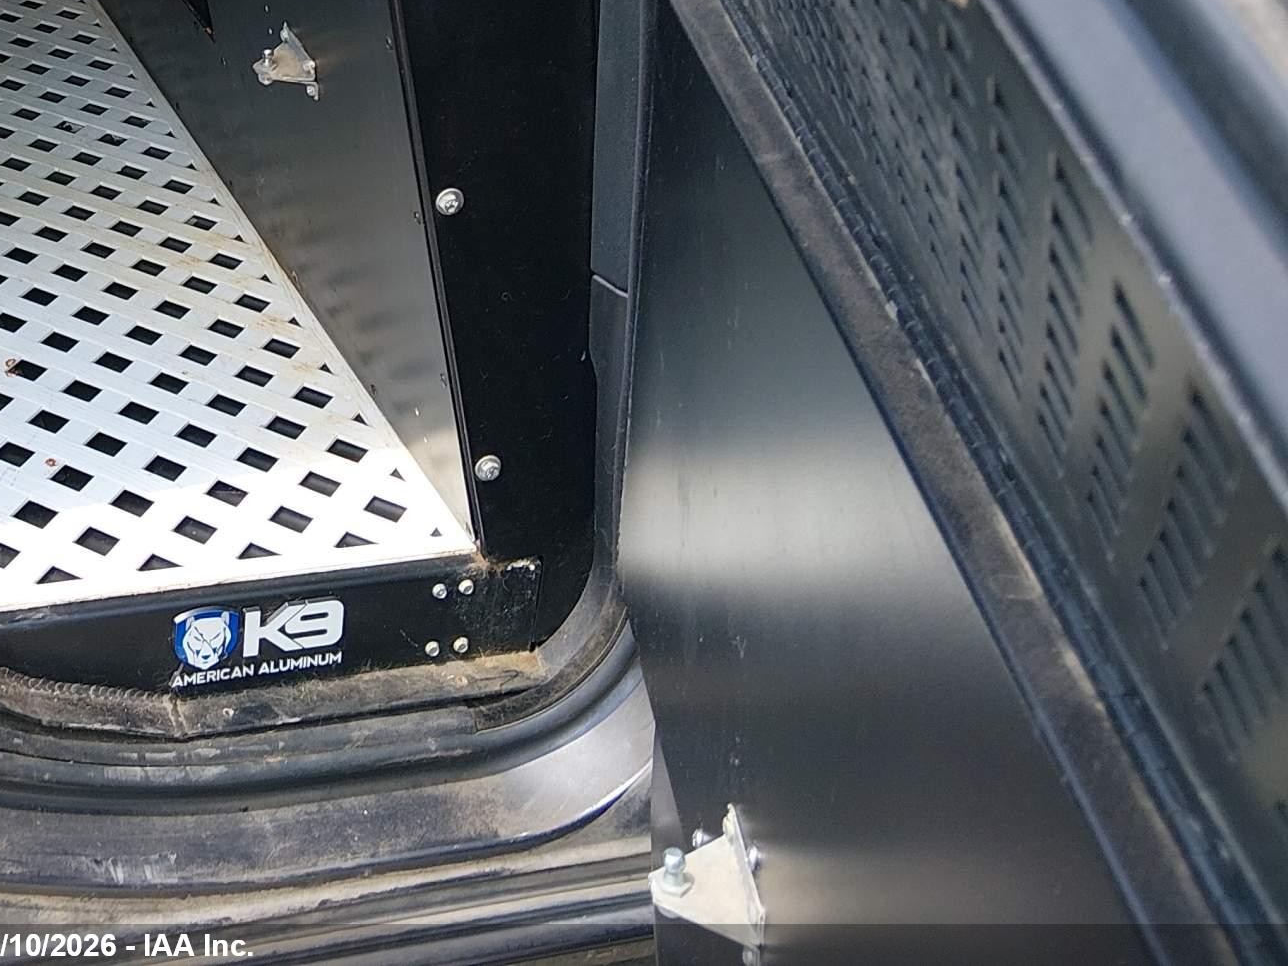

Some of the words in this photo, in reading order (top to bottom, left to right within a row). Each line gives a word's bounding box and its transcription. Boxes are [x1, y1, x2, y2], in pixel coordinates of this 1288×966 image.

[243, 600, 344, 657] K9
[171, 664, 255, 688] AMERICAN
[258, 652, 342, 675] ALUMINUM
